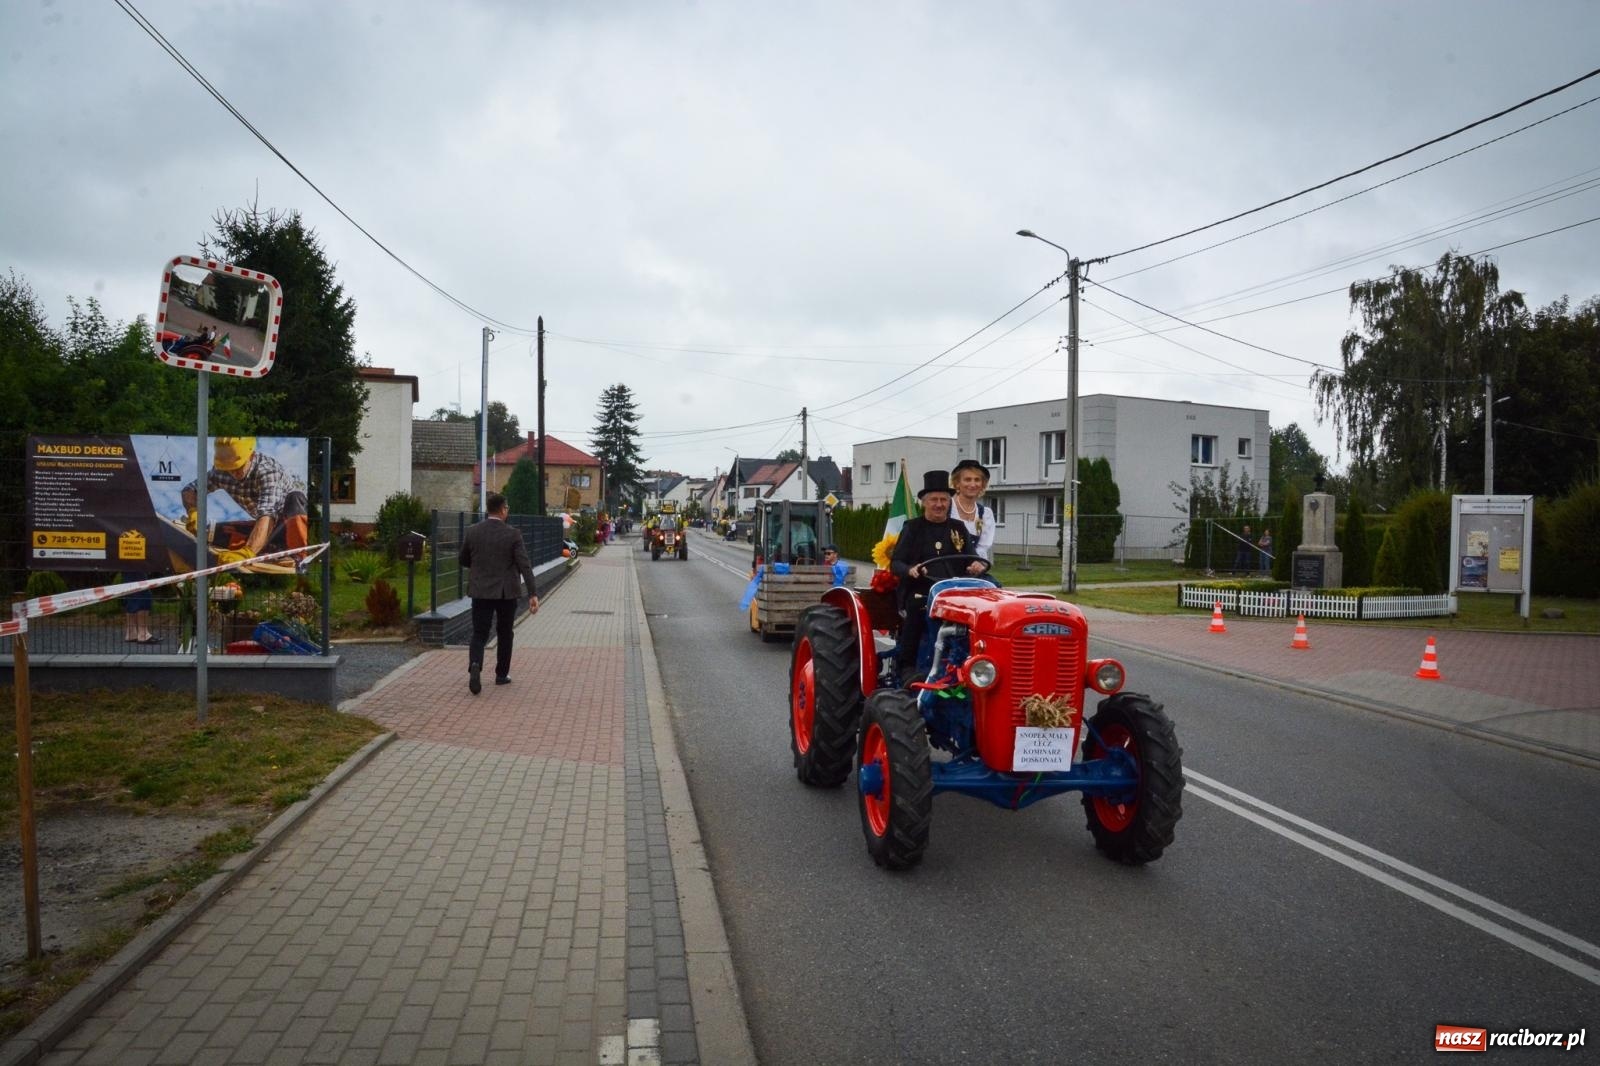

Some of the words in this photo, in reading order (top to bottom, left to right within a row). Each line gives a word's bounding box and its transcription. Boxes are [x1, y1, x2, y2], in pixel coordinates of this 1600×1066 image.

[37, 445, 82, 455] MAXBUD
[84, 446, 124, 456] DEKKER
[159, 461, 172, 473] M
[1023, 622, 1071, 636] SAME
